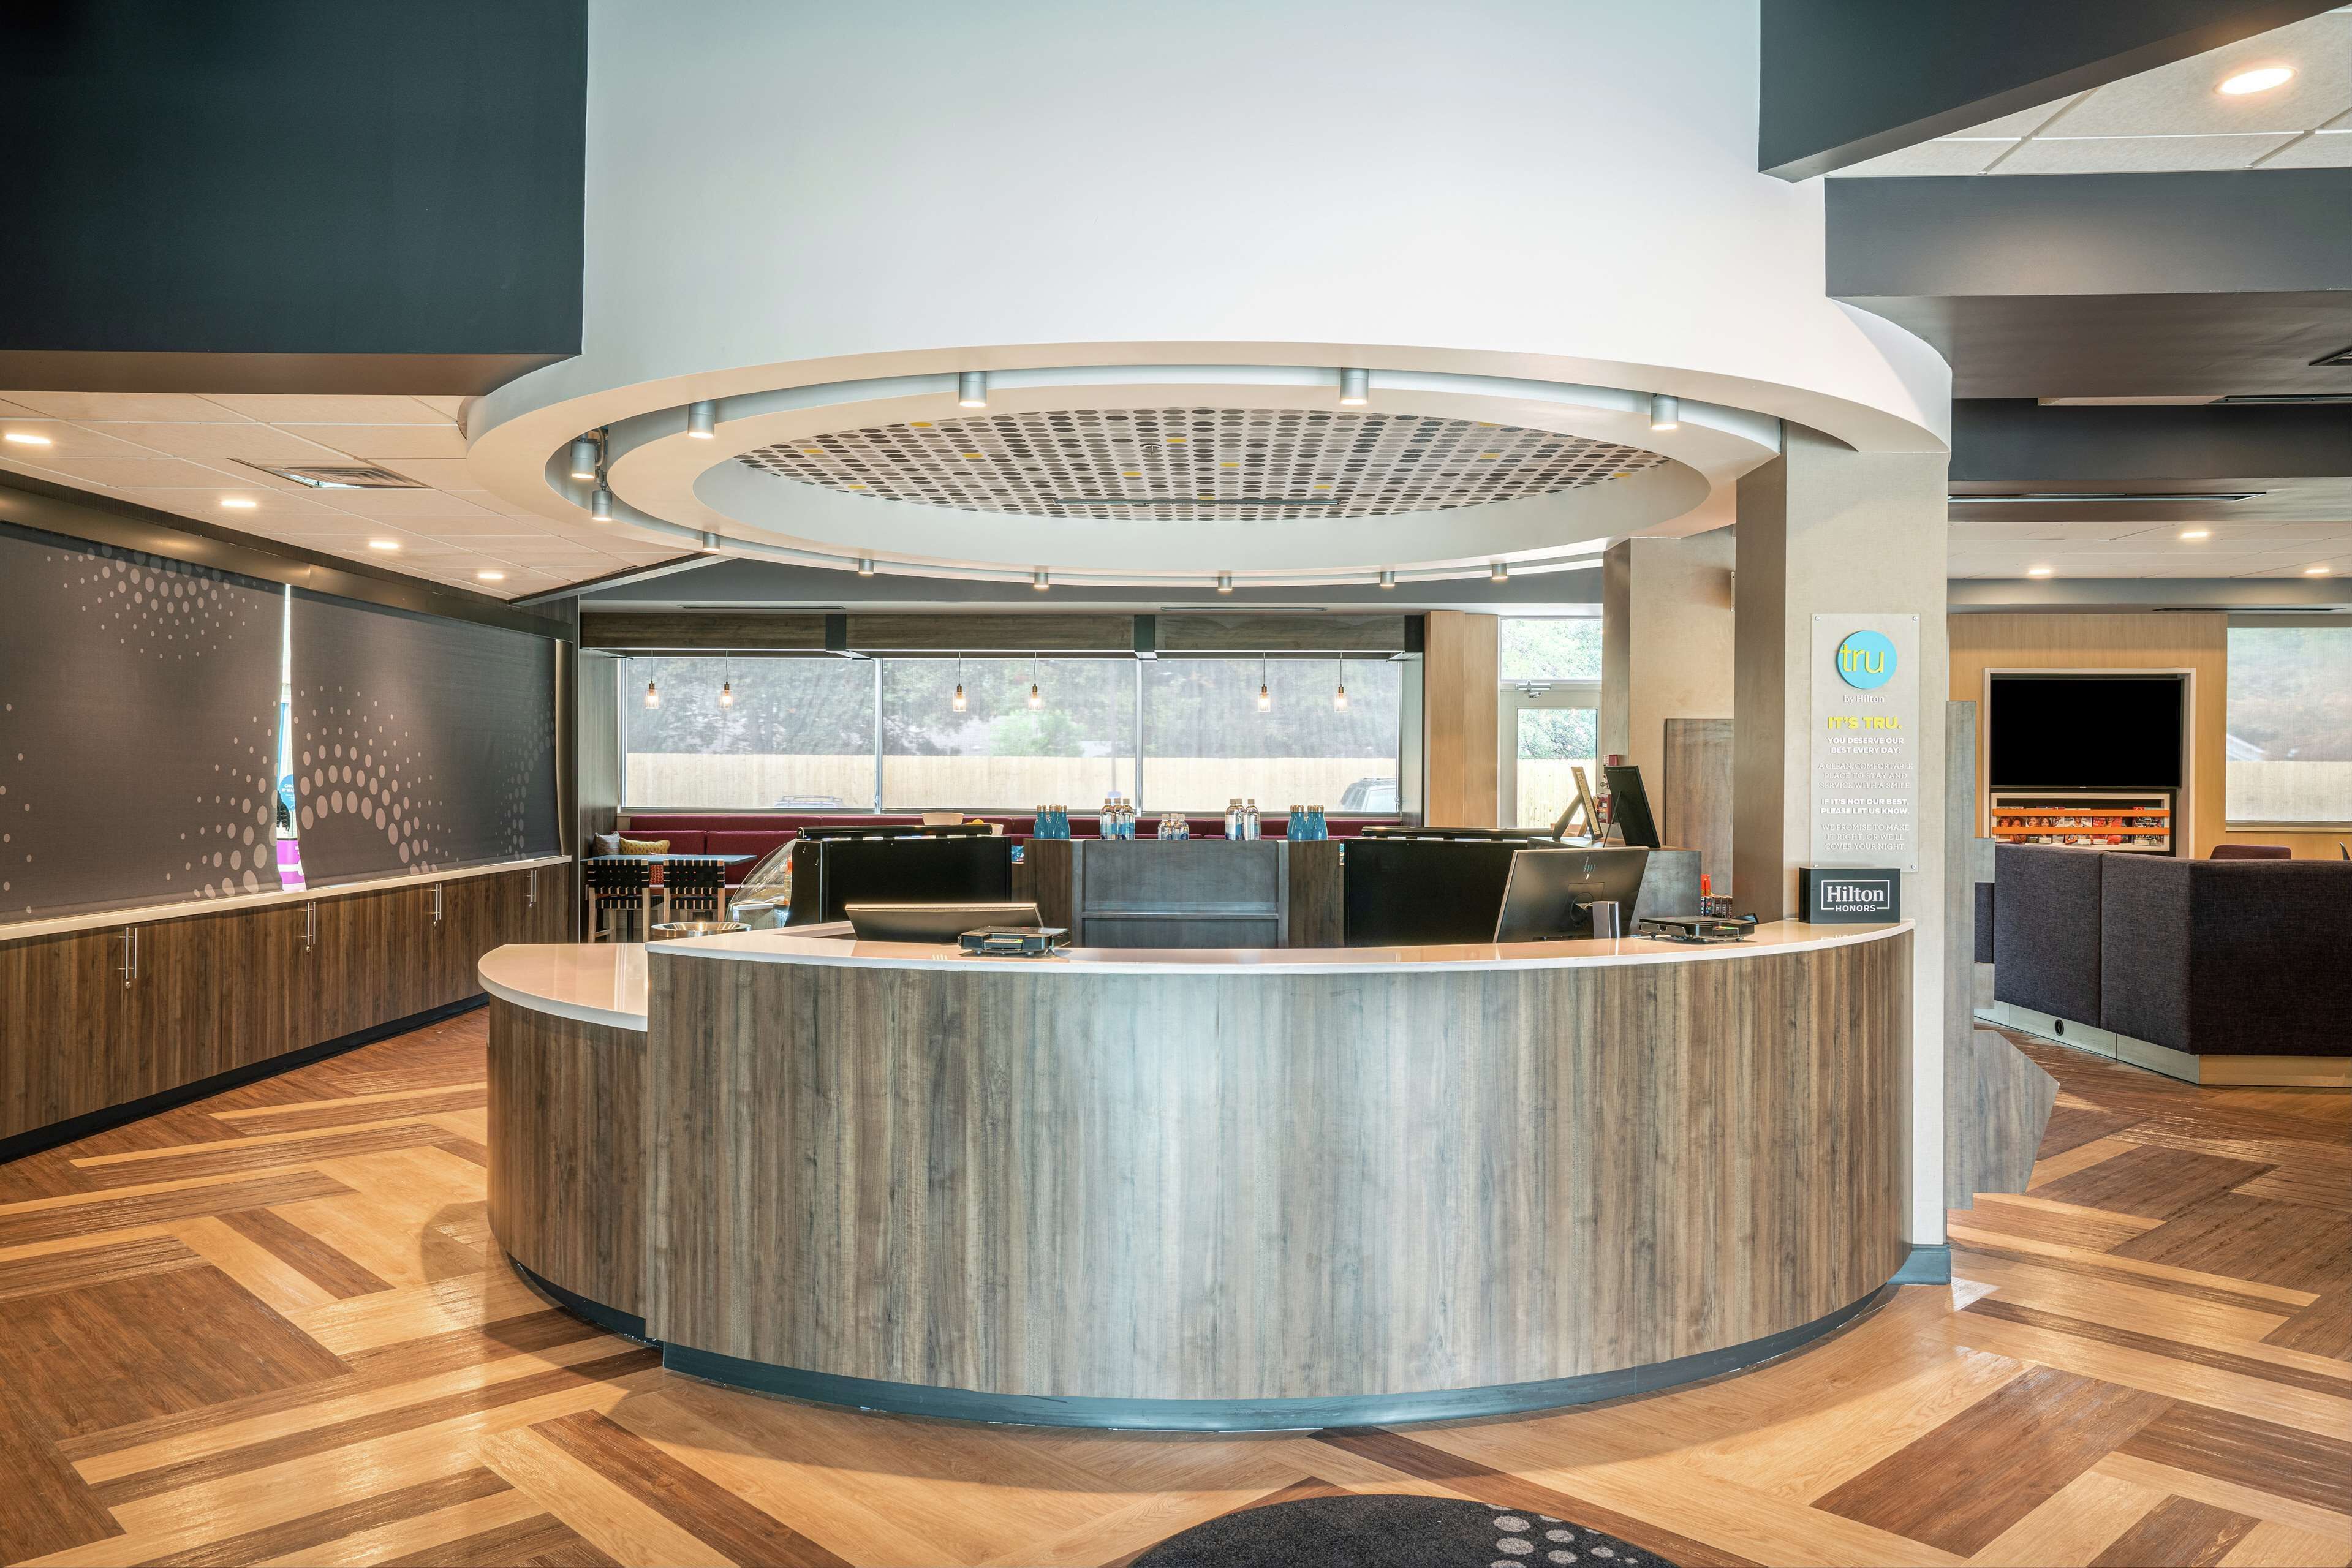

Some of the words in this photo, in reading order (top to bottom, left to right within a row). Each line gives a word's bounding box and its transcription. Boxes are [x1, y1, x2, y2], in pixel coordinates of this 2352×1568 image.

[1839, 643, 1884, 674] tru
[1843, 695, 1854, 704] by
[1828, 716, 1859, 729] IT'S
[1862, 716, 1902, 729] TRU.
[1827, 886, 1884, 902] Hilton
